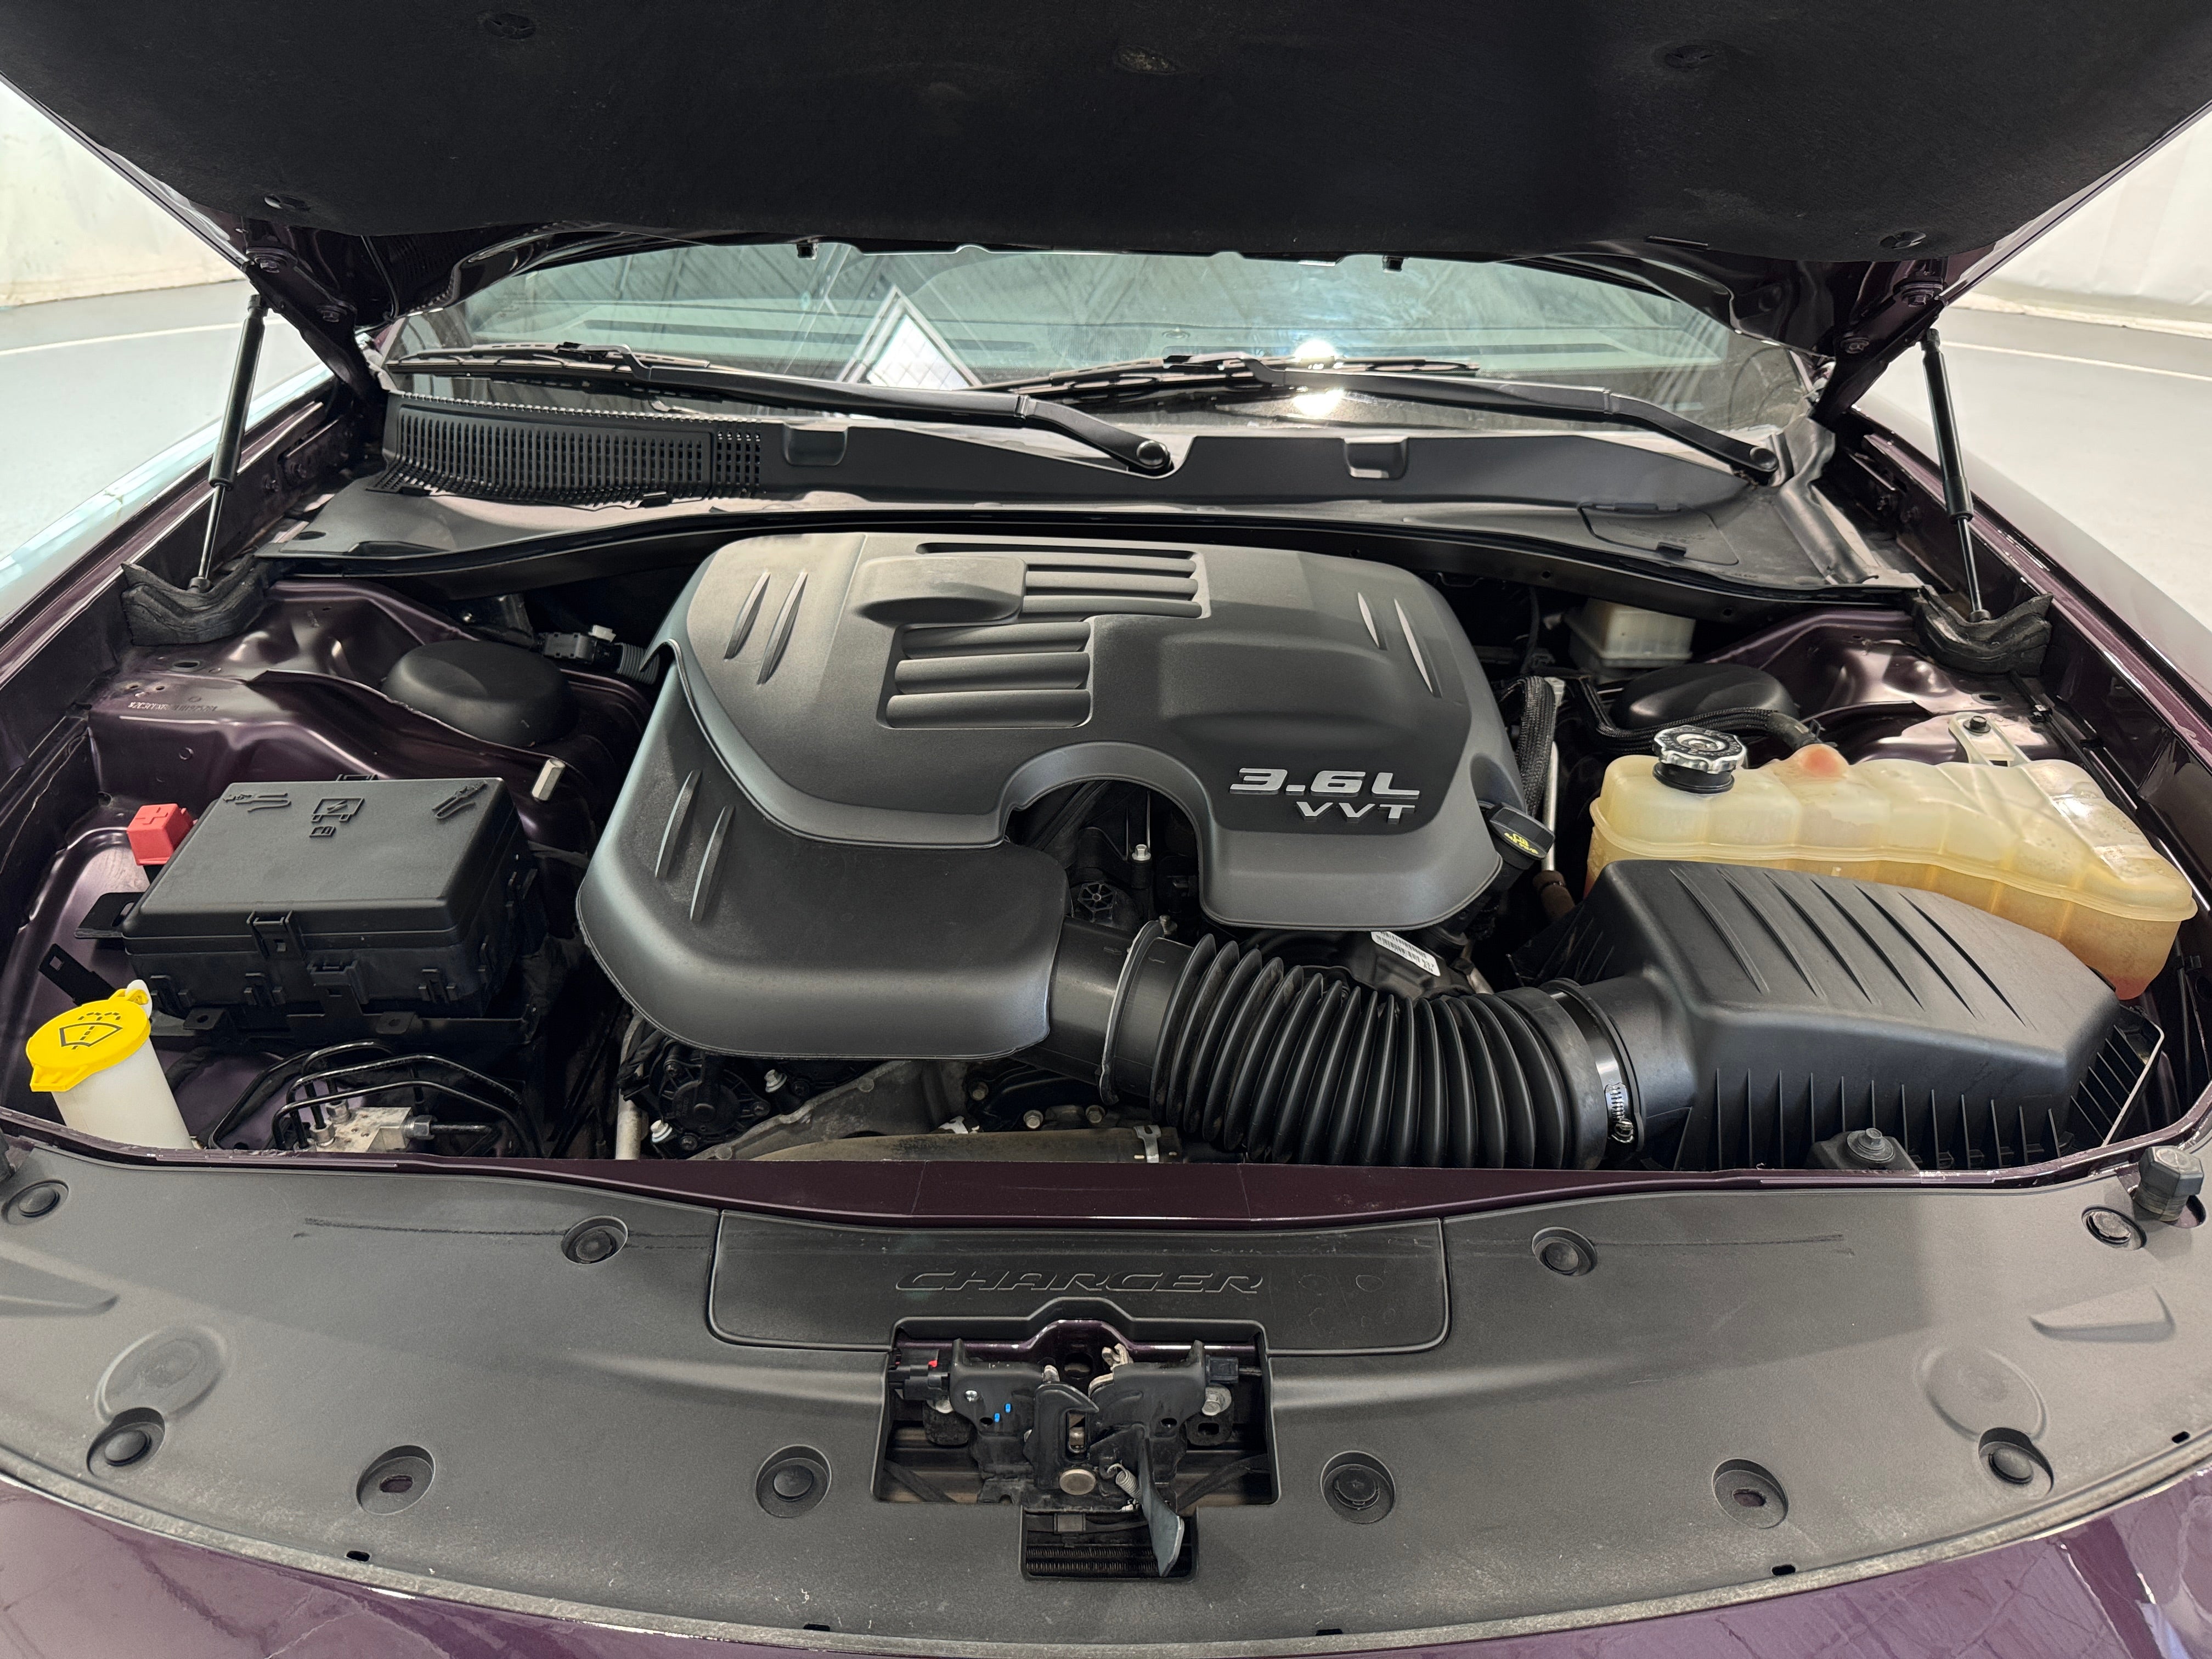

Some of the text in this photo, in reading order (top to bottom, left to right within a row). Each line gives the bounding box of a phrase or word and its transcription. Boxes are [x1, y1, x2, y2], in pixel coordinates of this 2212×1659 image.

[1229, 768, 1420, 798] 3.6L
[1295, 802, 1415, 822] VVT
[895, 1270, 1263, 1294] CHARGER
